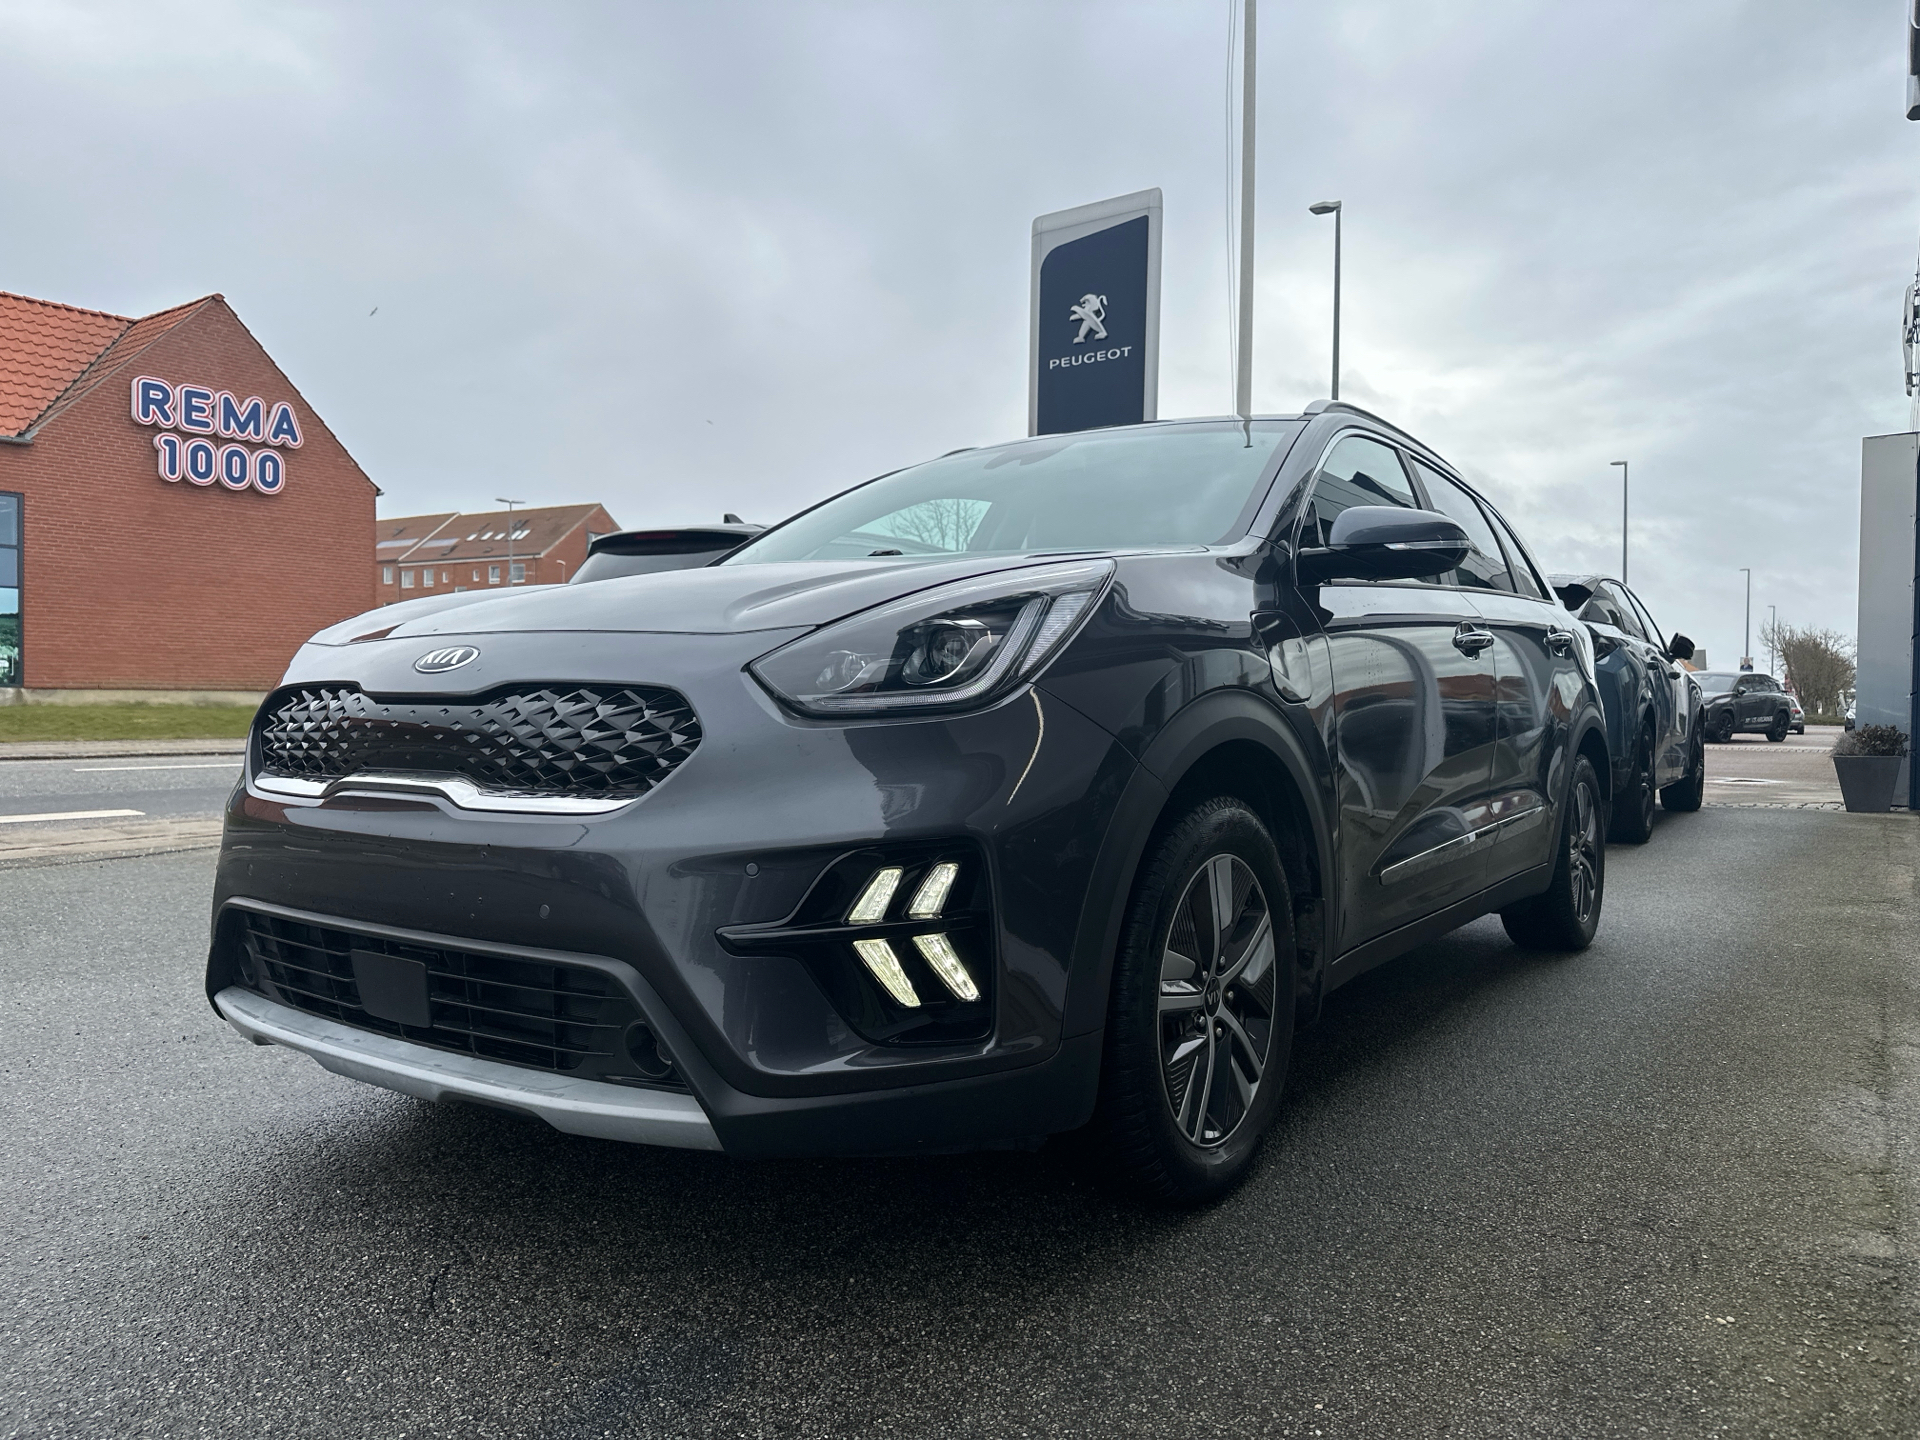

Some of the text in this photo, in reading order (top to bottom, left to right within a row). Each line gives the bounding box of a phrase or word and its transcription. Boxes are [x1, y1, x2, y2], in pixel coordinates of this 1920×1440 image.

[1049, 346, 1132, 370] PEUGEOT
[133, 376, 303, 449] REMA
[154, 433, 285, 494] 1000
